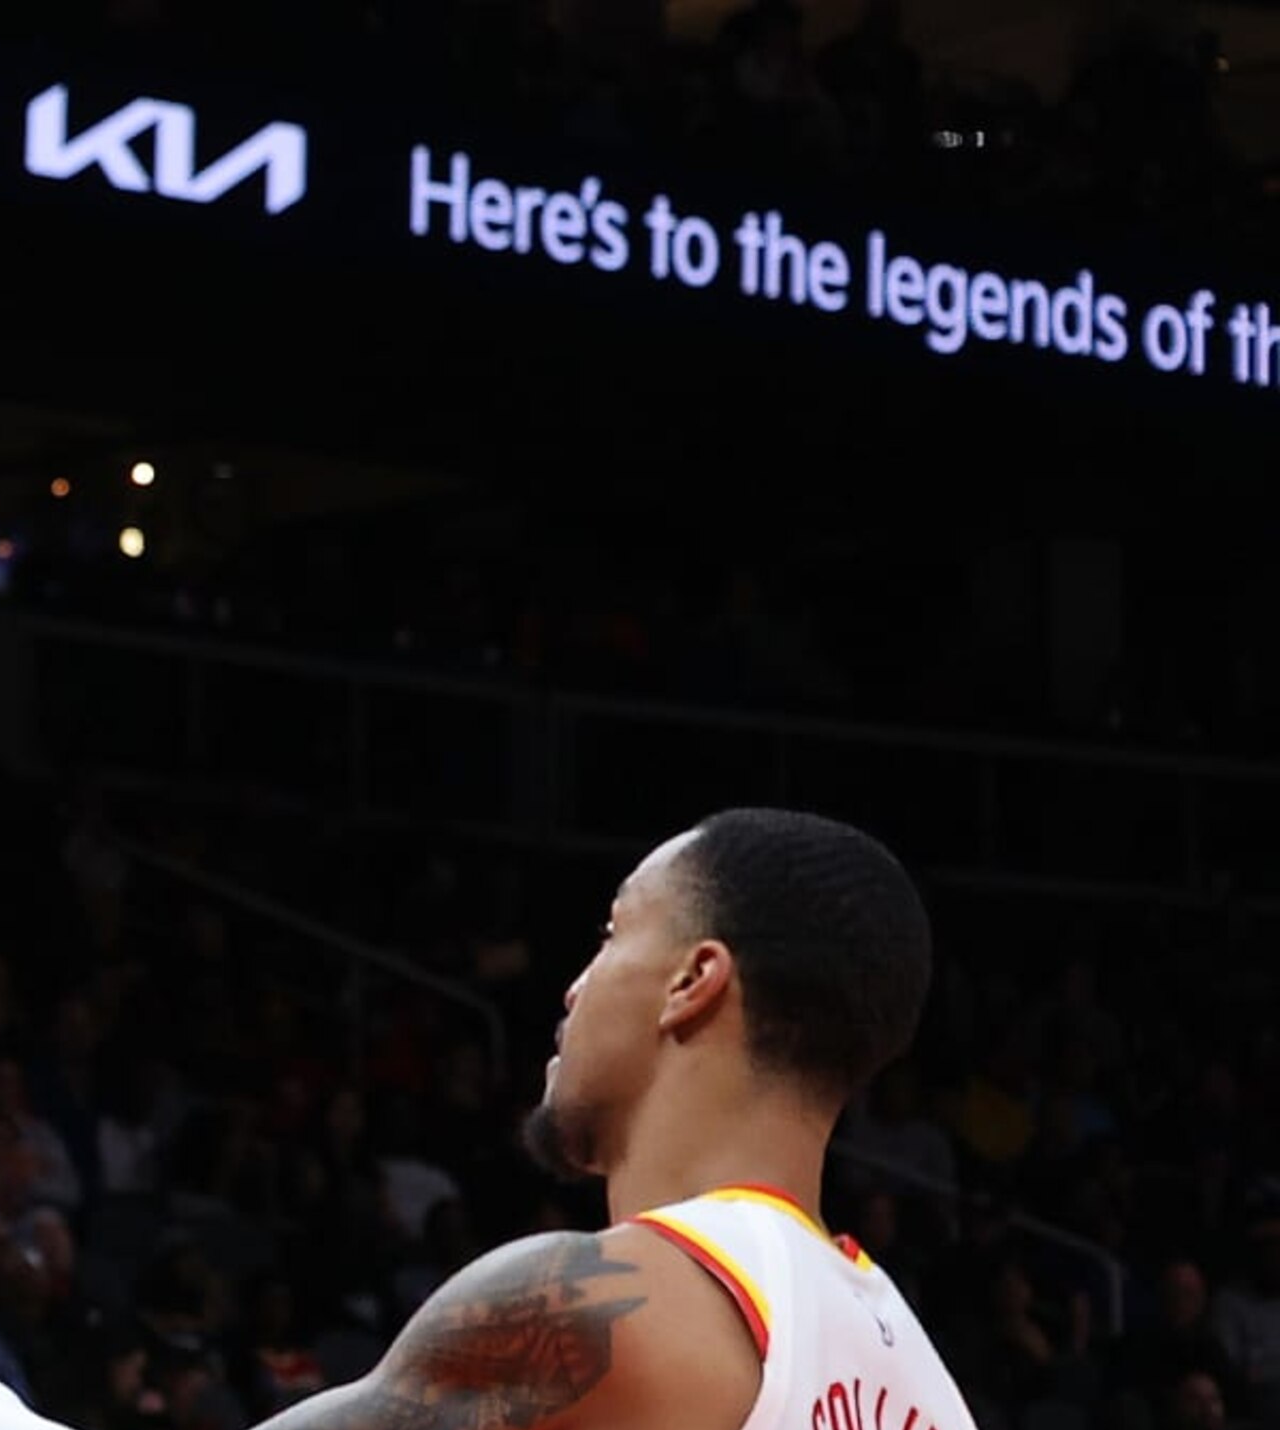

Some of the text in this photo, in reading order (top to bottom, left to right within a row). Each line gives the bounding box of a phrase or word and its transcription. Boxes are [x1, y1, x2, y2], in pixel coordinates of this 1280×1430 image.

[409, 145, 630, 271] Here's
[645, 196, 719, 287] to
[735, 212, 850, 311] the
[868, 231, 1129, 354] legends
[1144, 289, 1216, 374] of
